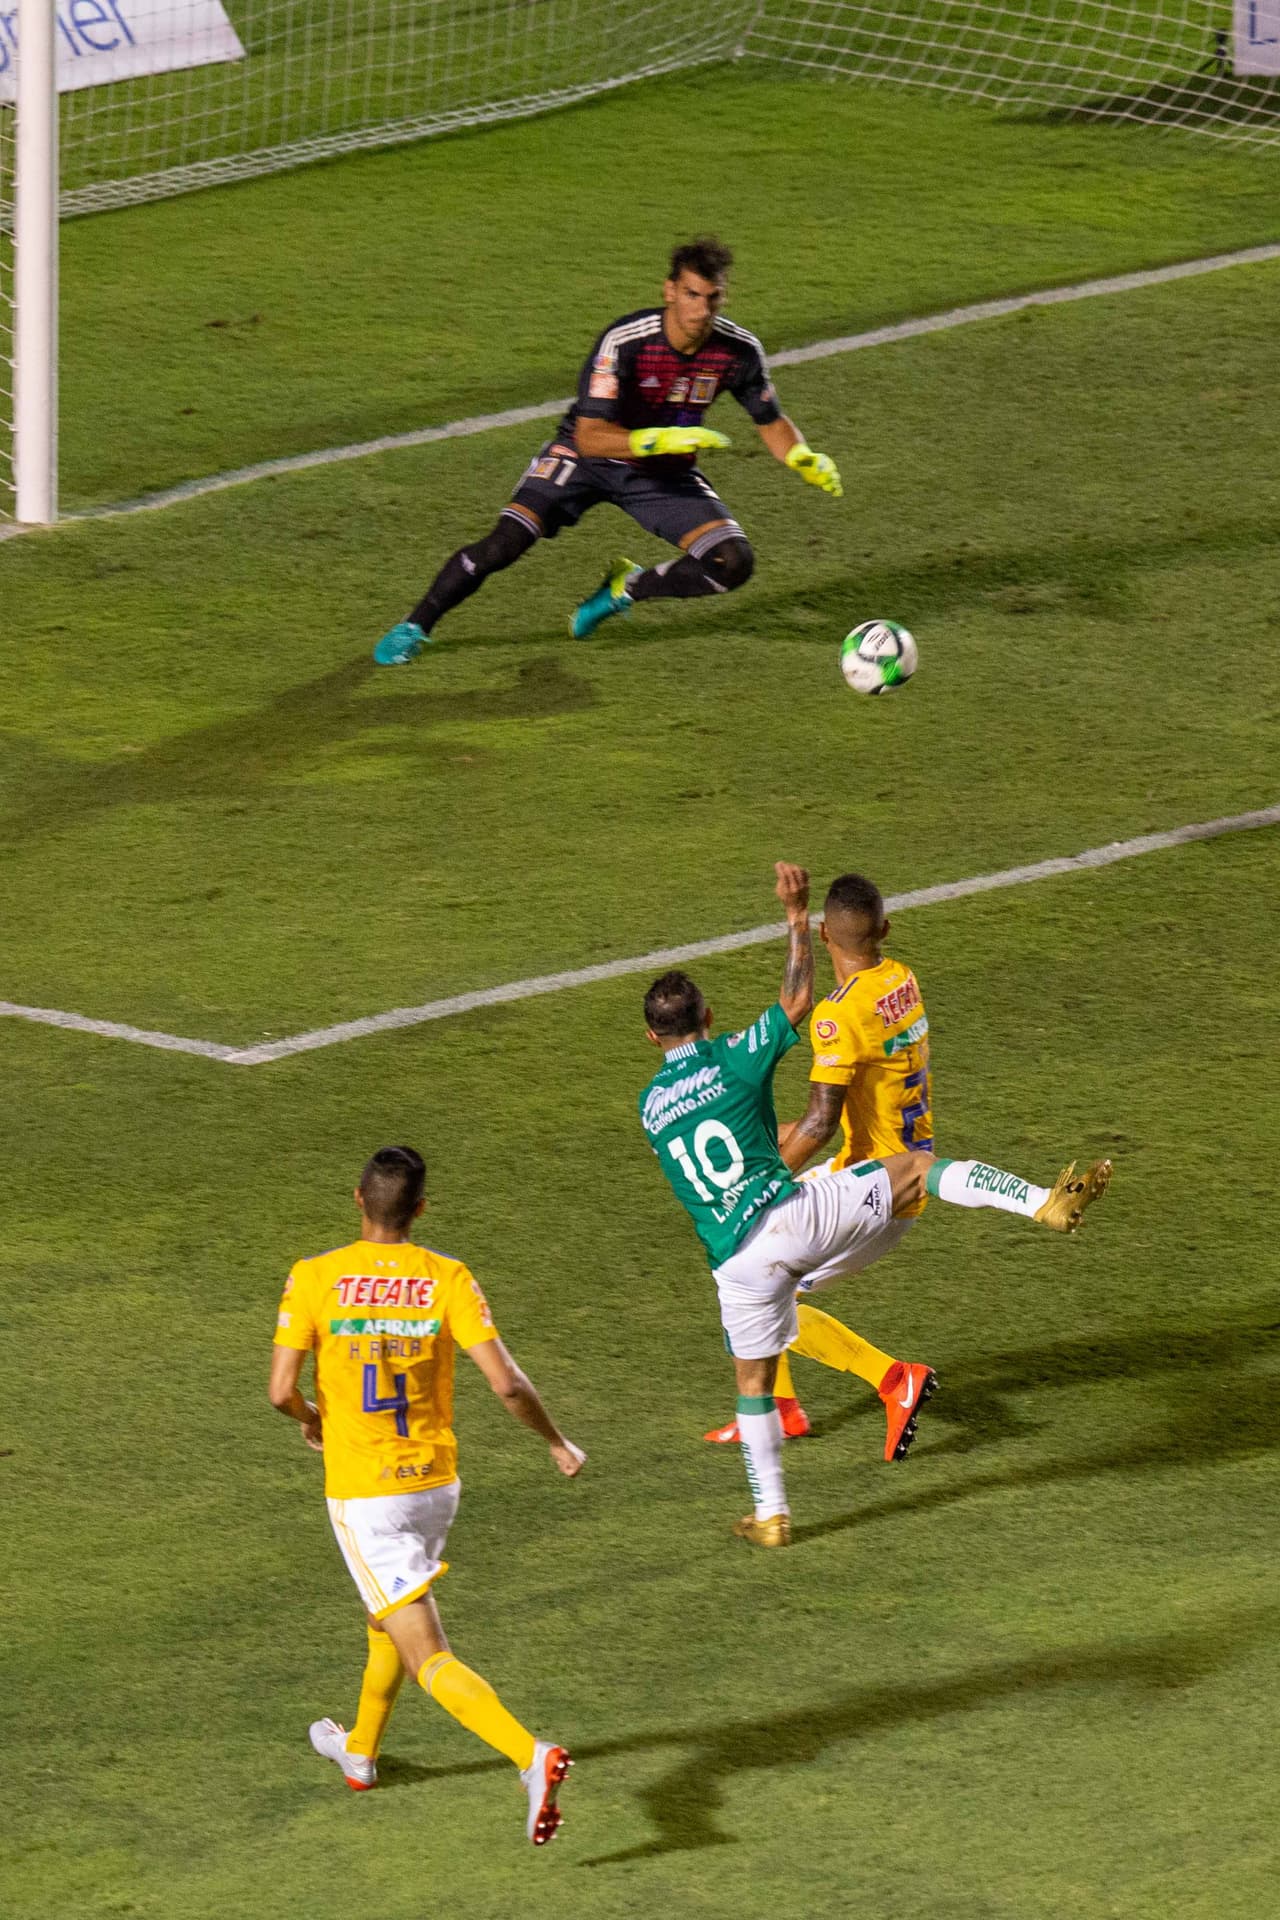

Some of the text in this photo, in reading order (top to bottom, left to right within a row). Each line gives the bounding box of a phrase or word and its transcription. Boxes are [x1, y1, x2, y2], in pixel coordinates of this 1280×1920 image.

[667, 1119, 744, 1202] 10
[965, 1163, 1029, 1204] PERDURA
[333, 1275, 438, 1308] TECATE
[362, 1363, 410, 1438] 4
